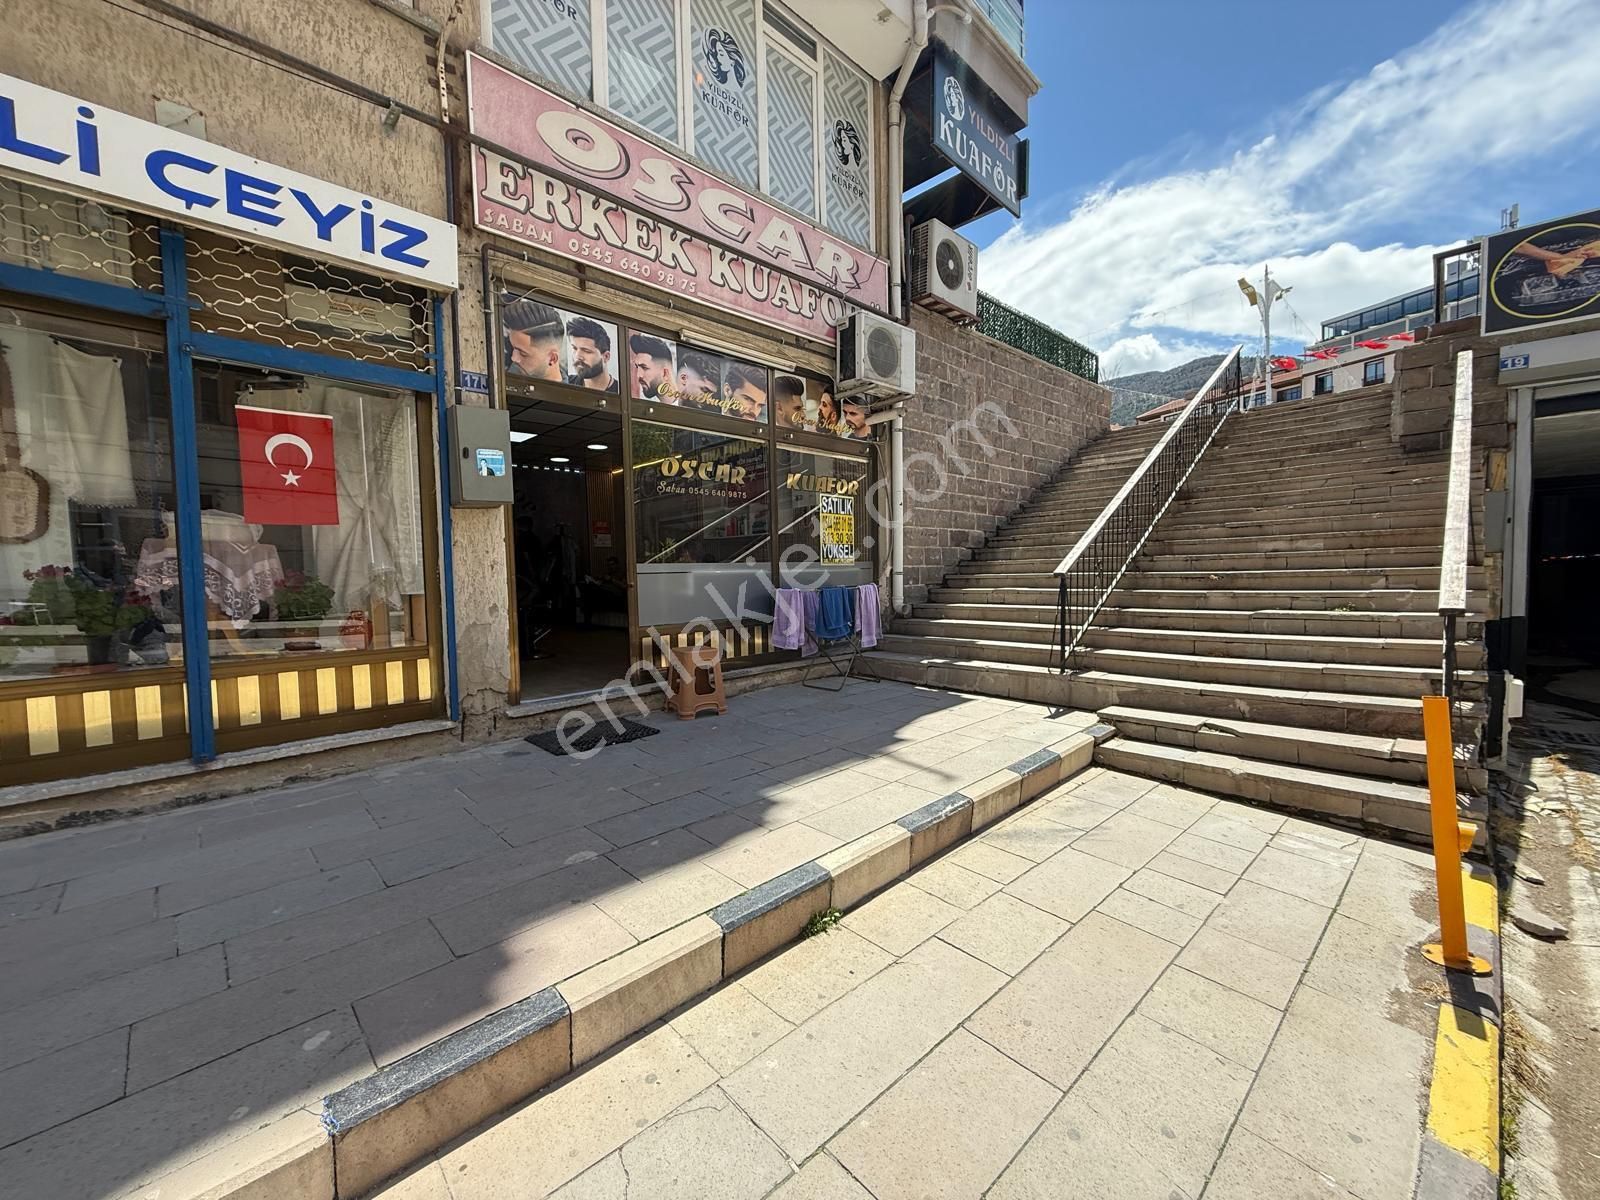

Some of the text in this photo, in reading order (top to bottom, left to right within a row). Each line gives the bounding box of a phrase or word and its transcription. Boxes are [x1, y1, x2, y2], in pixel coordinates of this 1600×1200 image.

[702, 91, 749, 127] KUAFÖR
[707, 82, 744, 111] YILDIZLI
[939, 112, 1018, 204] KUAFÖR
[968, 104, 1016, 168] YILDIZLI
[145, 150, 431, 269] ÇEYİZ
[479, 147, 697, 276] ERKEK
[536, 111, 861, 289] OSCAR
[568, 238, 614, 264] 0545
[620, 257, 651, 277] 640
[657, 270, 675, 286] 98
[680, 279, 697, 293] 75
[1503, 356, 1525, 368] 19
[660, 456, 747, 485] OSCAR
[688, 487, 709, 496] 0545
[711, 489, 726, 497] 640
[728, 491, 747, 499] 9875
[821, 496, 853, 515] SATILIK
